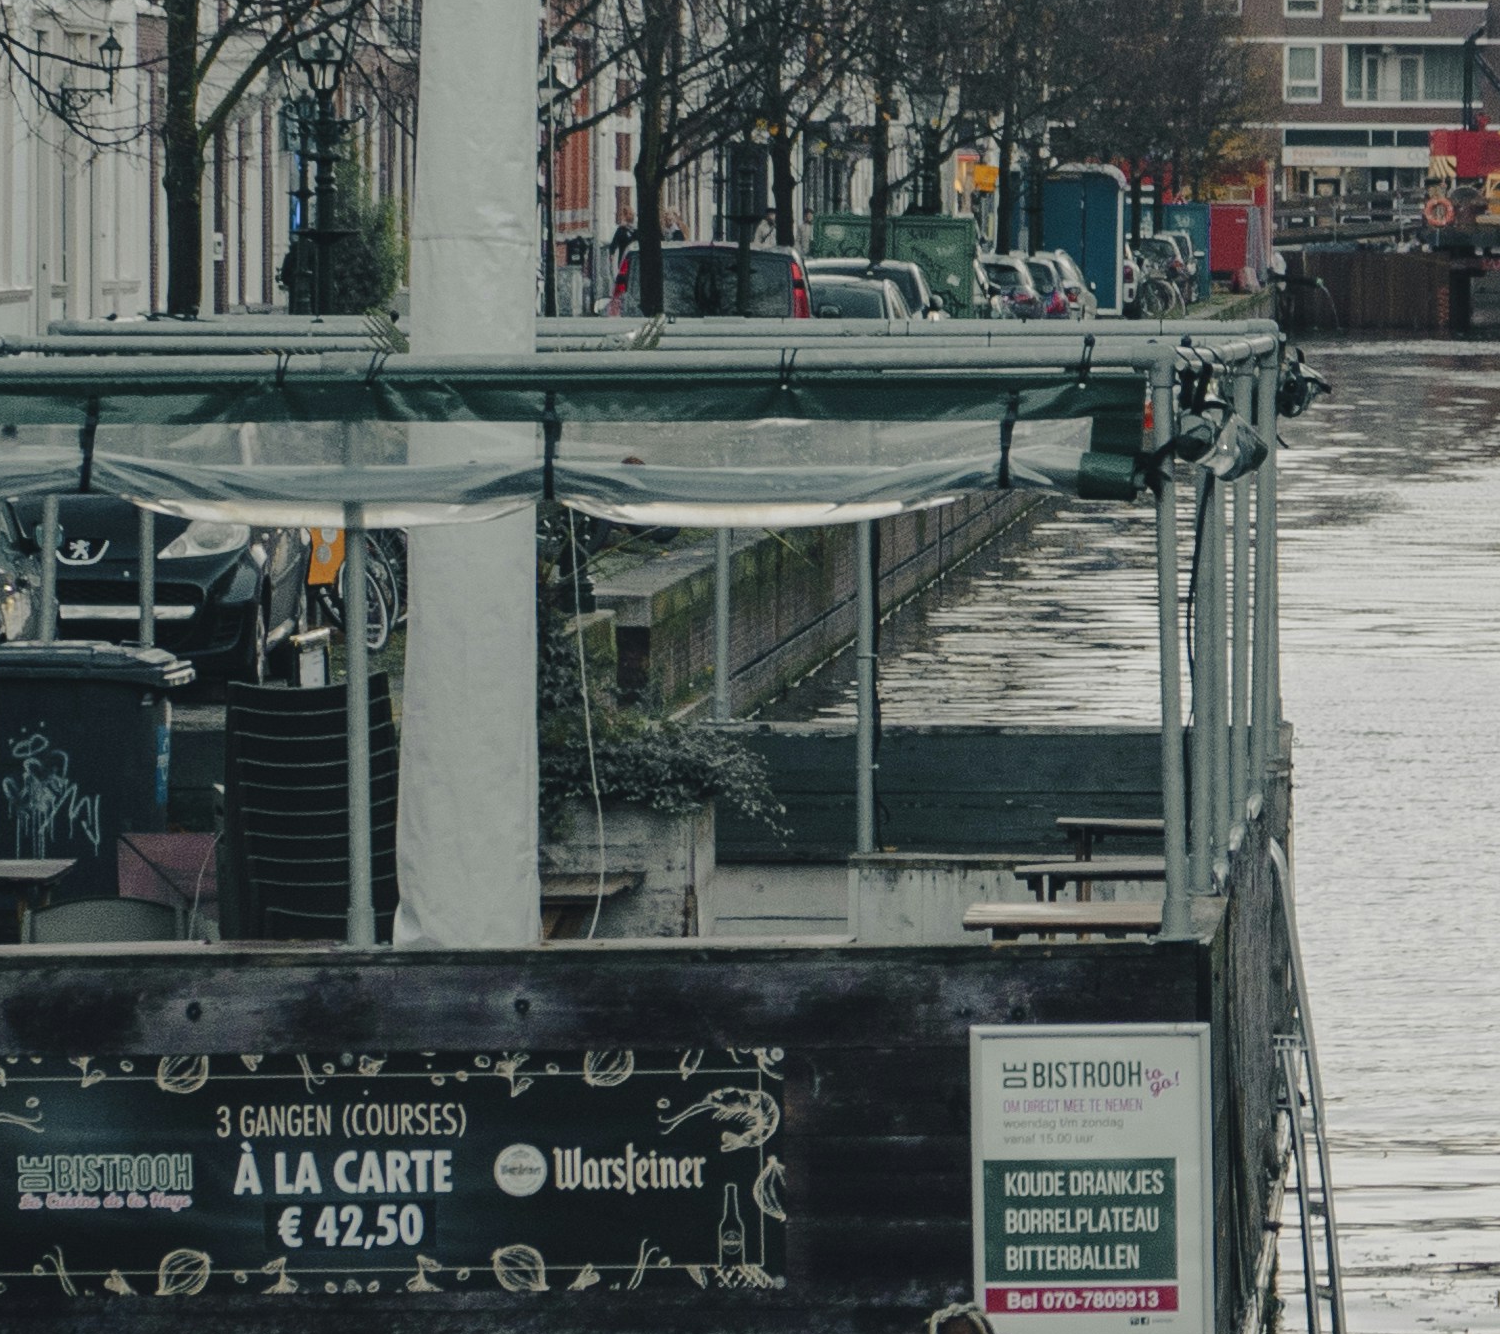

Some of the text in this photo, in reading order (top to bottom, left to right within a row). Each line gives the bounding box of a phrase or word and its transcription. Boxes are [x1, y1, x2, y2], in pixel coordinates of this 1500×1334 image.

[1003, 1062, 1027, 1089] DE
[1033, 1061, 1142, 1089] BISTROOH
[1003, 1098, 1143, 1114] OM DIRECT MEE TE NEMEN
[216, 1103, 467, 1138] 3 GANGEN (COURSES)
[1082, 1117, 1124, 1130] zondag
[1004, 1133, 1036, 1145] vanaf
[1076, 1134, 1094, 1144] uur
[17, 1154, 193, 1192] DE BISTROOH
[233, 1141, 453, 1195] À LA CARTE
[552, 1142, 707, 1195] Warsteiner
[1005, 1170, 1164, 1197] KOUDE DRANKJES
[278, 1204, 424, 1250] € 42,50
[1005, 1207, 1159, 1234] BORRELPLATEAU
[1005, 1244, 1140, 1271] BITTERBALLEN
[1007, 1291, 1038, 1310] Bel
